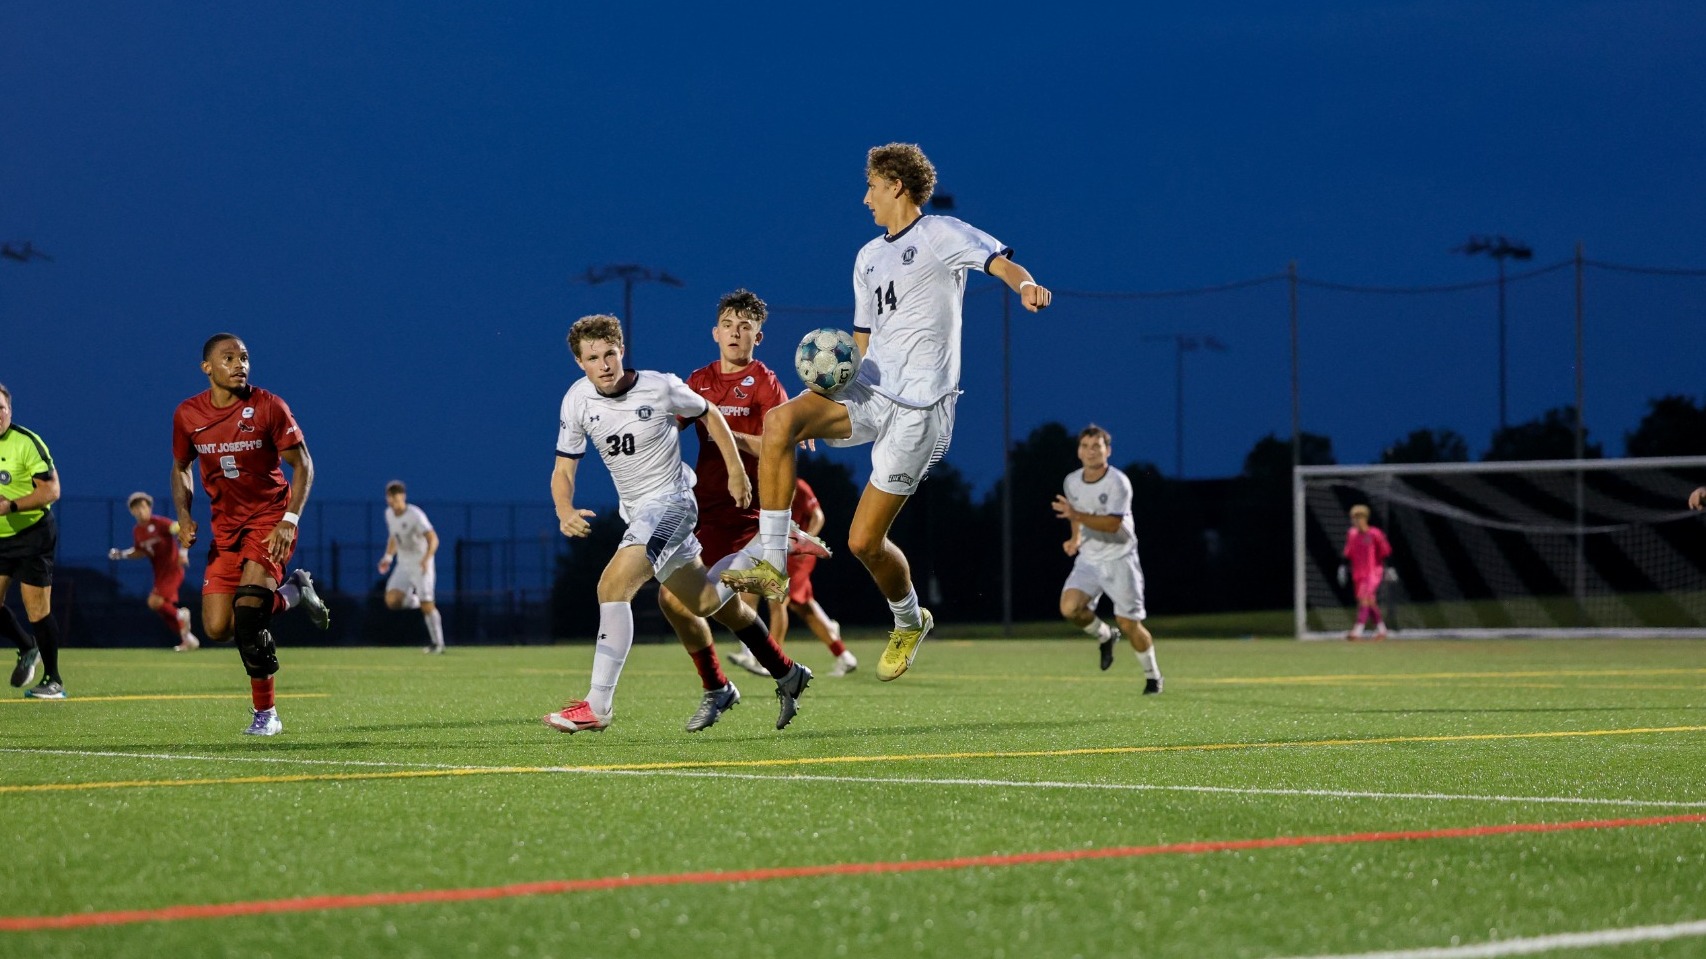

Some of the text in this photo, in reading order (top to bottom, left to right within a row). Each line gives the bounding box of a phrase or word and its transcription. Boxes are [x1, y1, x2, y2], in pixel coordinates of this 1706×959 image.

[875, 280, 897, 315] 14
[717, 405, 751, 417] SEPH'S
[194, 440, 262, 454] AINT JOSEPH'S
[606, 433, 636, 456] 30
[220, 455, 240, 479] 5
